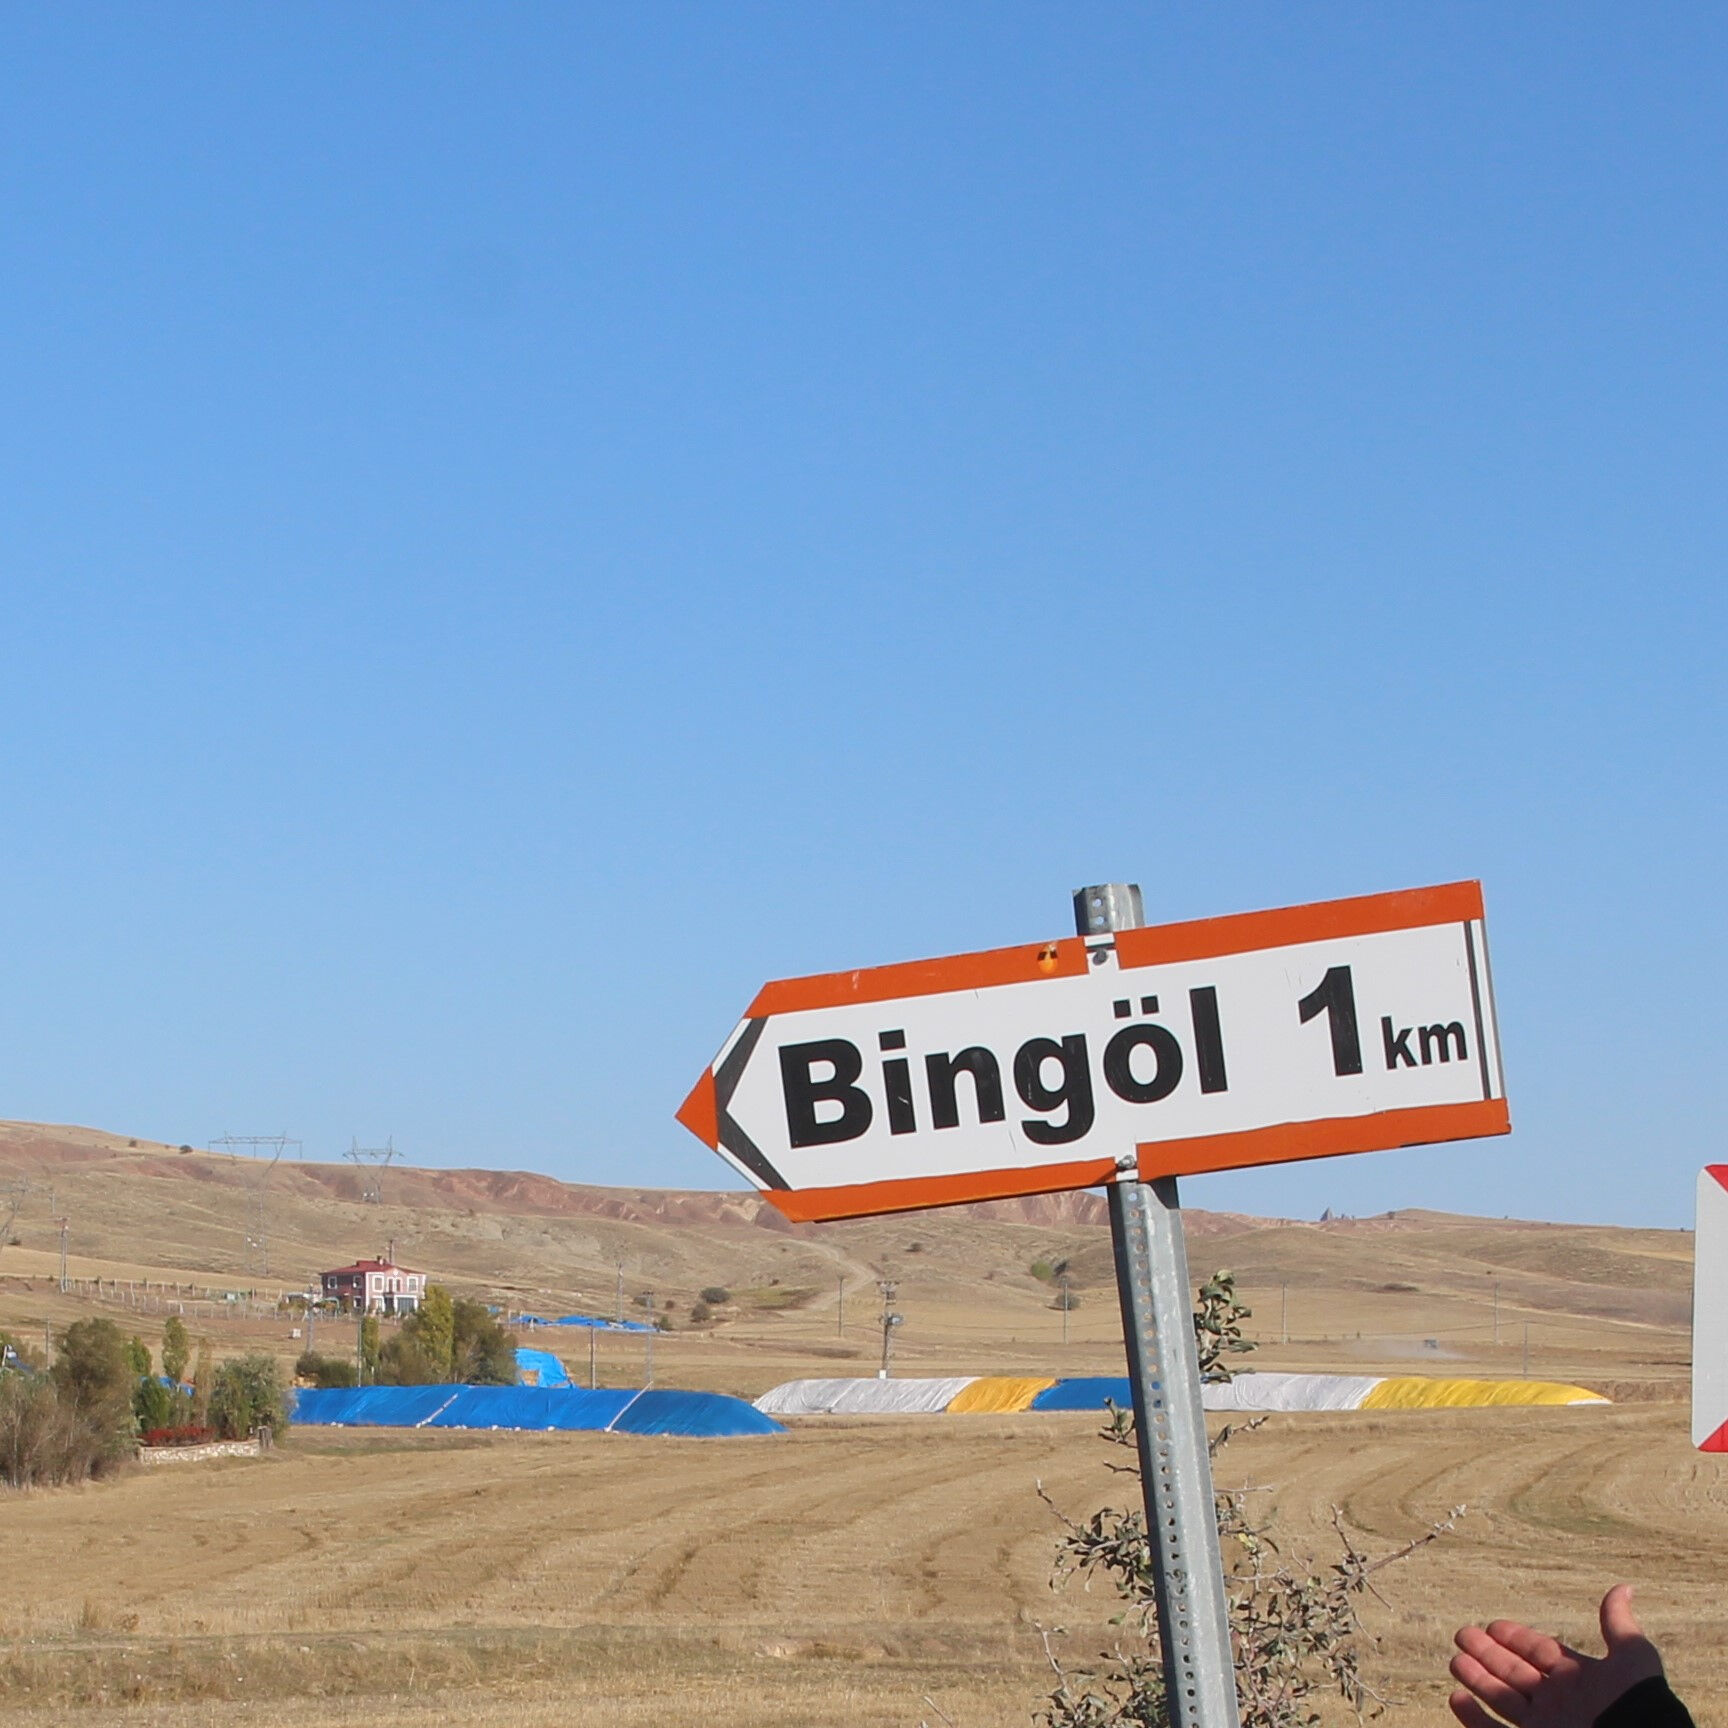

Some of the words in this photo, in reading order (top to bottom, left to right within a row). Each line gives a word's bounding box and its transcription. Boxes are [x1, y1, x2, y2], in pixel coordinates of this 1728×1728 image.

[777, 985, 1229, 1149] Bingöl
[1297, 965, 1364, 1077] 1
[1381, 1016, 1469, 1070] km
